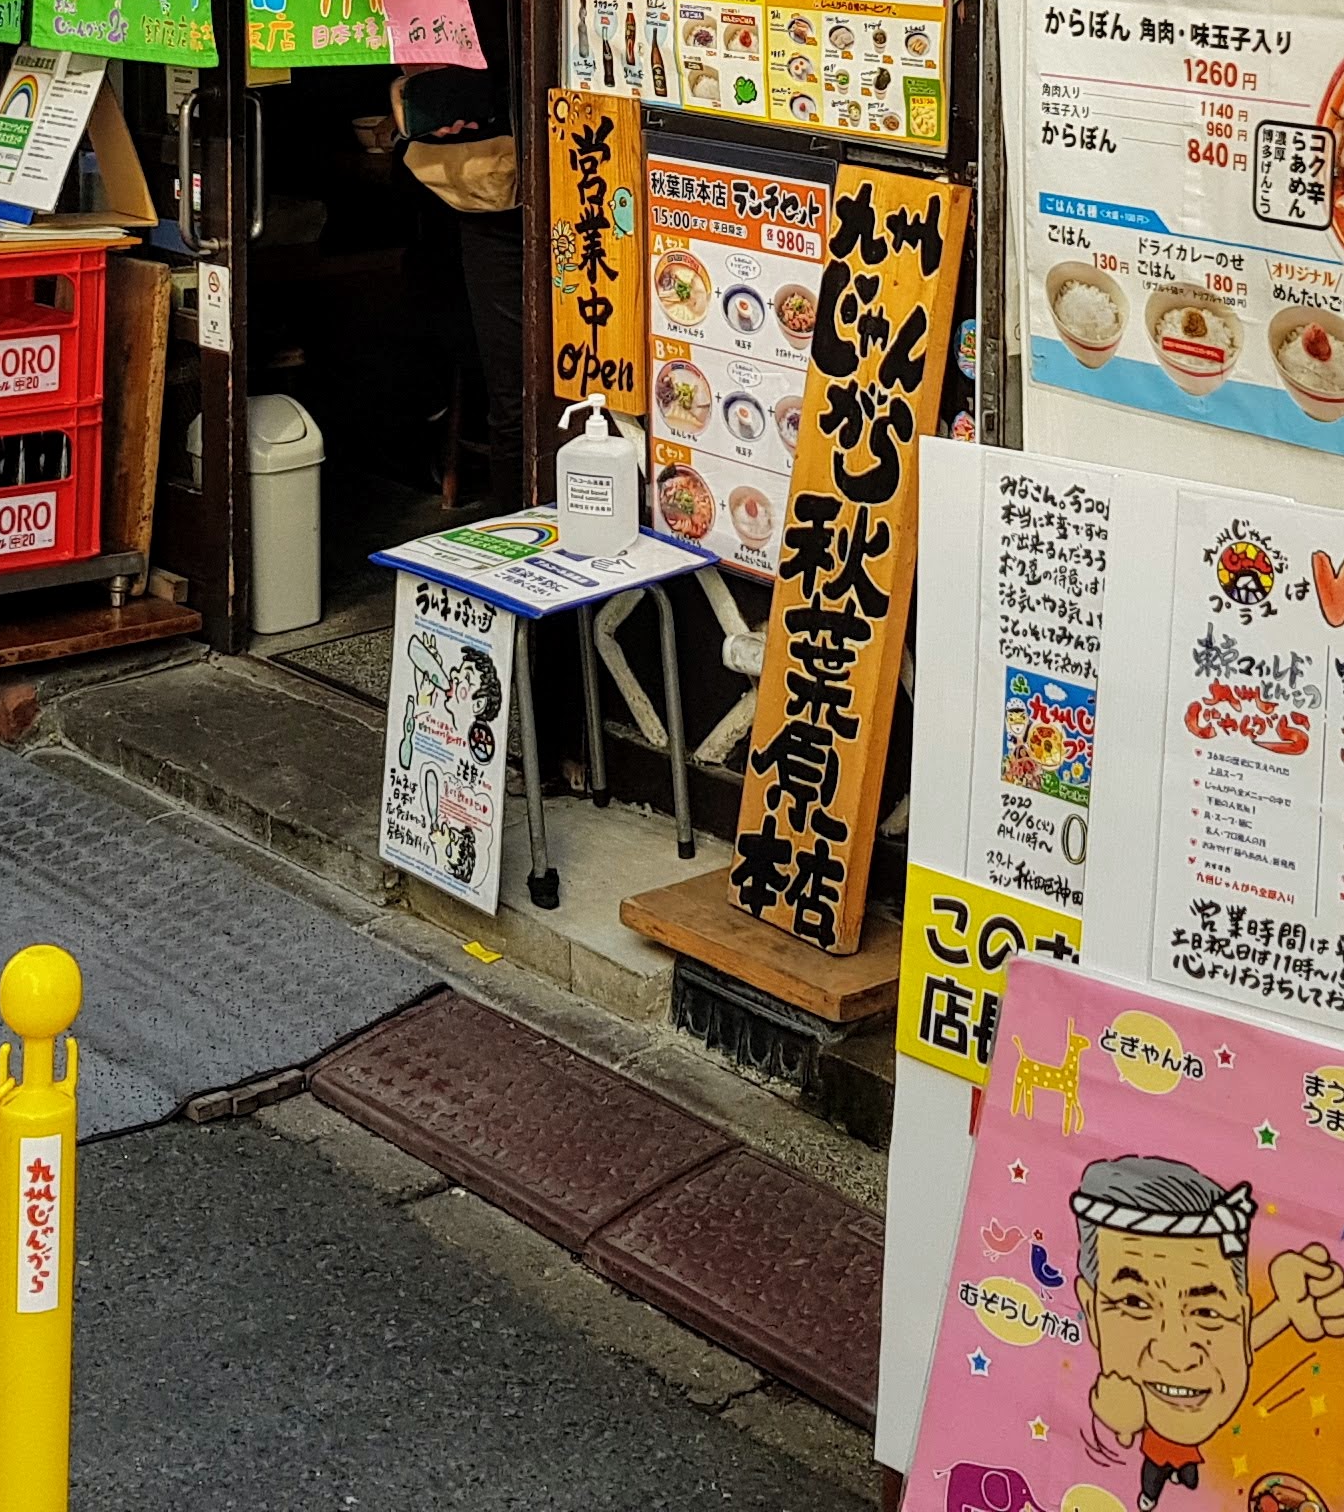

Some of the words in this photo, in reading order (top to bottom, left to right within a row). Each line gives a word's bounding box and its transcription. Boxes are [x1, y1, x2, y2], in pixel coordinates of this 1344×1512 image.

[1044, 6, 1131, 42] からぼん
[1140, 18, 1293, 55] 角肉・味玉子入り
[1041, 122, 1117, 154] からぼん
[650, 172, 727, 208] 秋葉原本店
[733, 182, 820, 226] ランチセット
[1288, 131, 1307, 219] らあめん
[570, 117, 619, 352] 営業中
[1048, 224, 1091, 249] ごはん
[1138, 237, 1244, 271] ドライカレーのせ
[1137, 260, 1176, 281] ごはん
[1272, 261, 1337, 287] オリジナル
[1097, 1028, 1205, 1080] どぎゃんね
[23, 1157, 56, 1294] 九州じゃんがら
